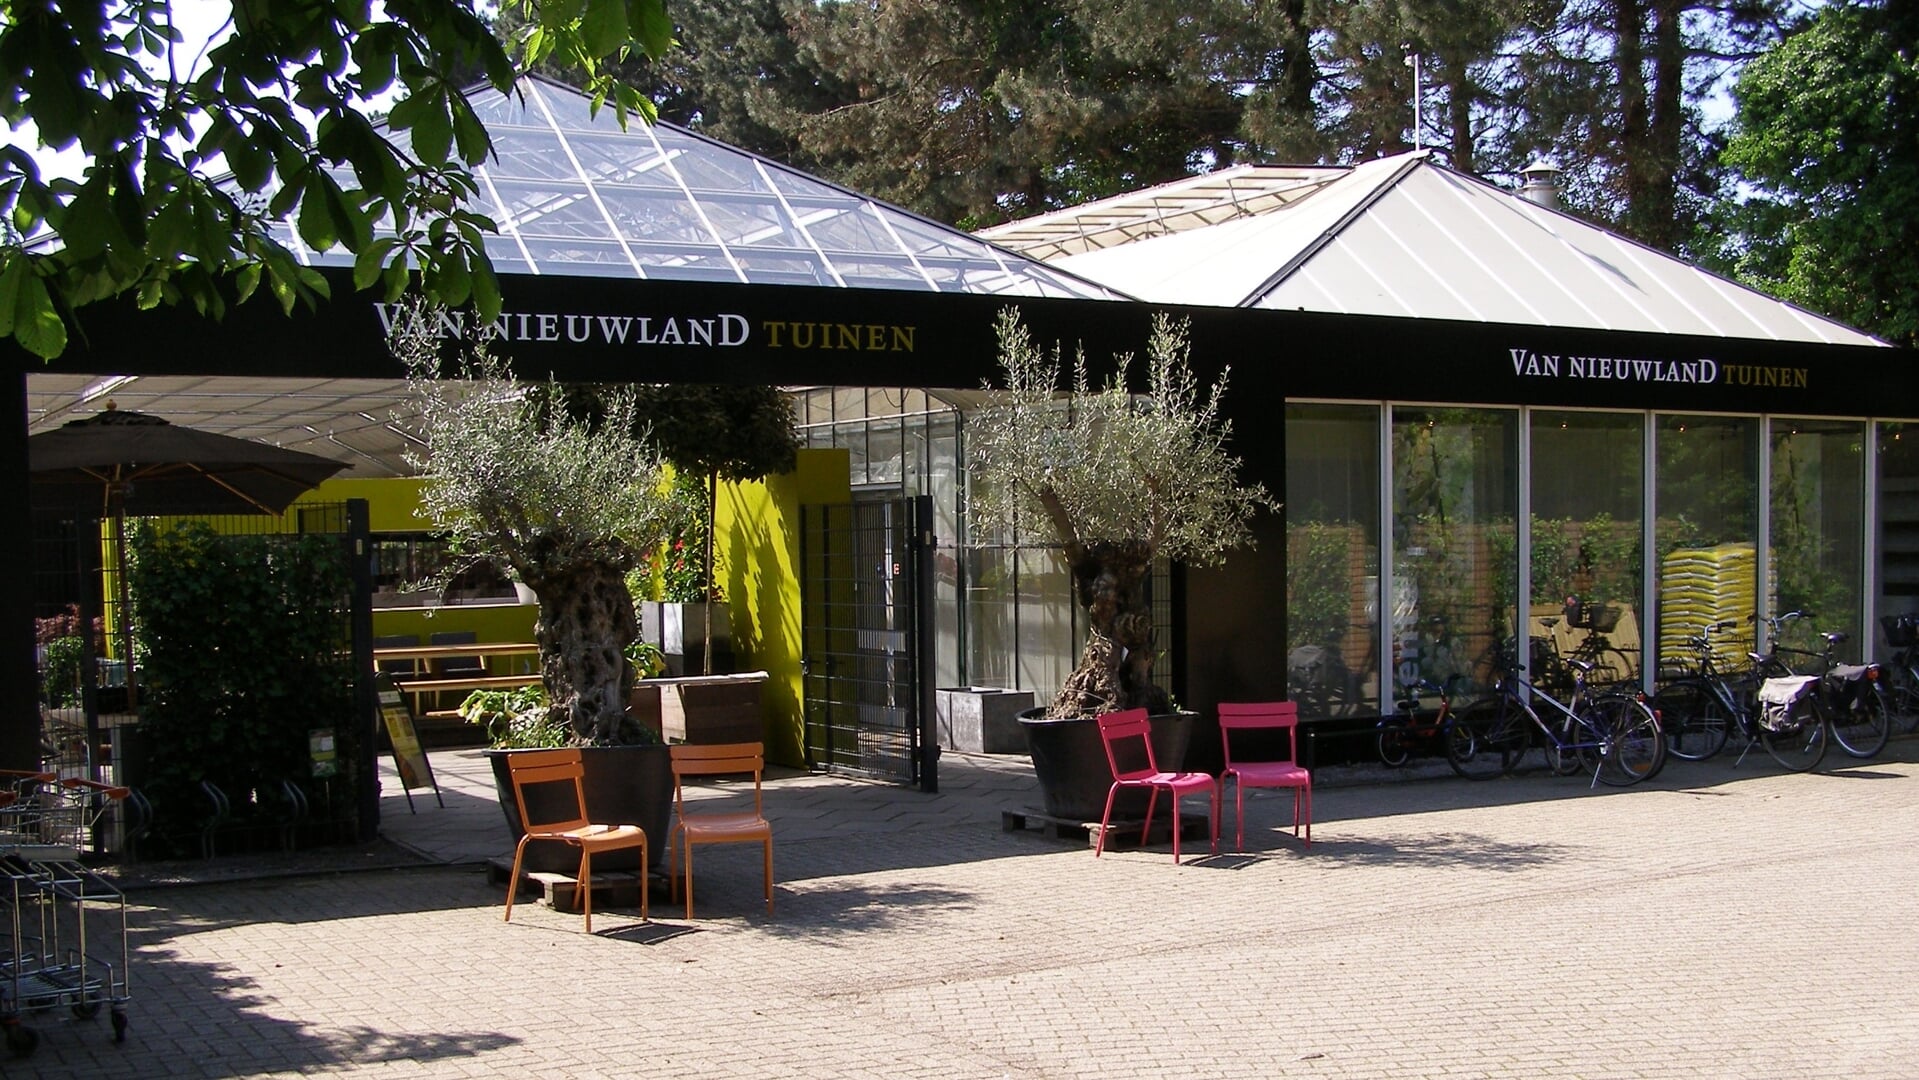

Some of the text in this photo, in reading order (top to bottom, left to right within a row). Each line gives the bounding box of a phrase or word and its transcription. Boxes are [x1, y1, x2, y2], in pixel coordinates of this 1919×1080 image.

[373, 302, 917, 353] VAN NIEUWLAND TUINEN
[1509, 348, 1809, 389] VAN NIEUWLAND TUINEN
